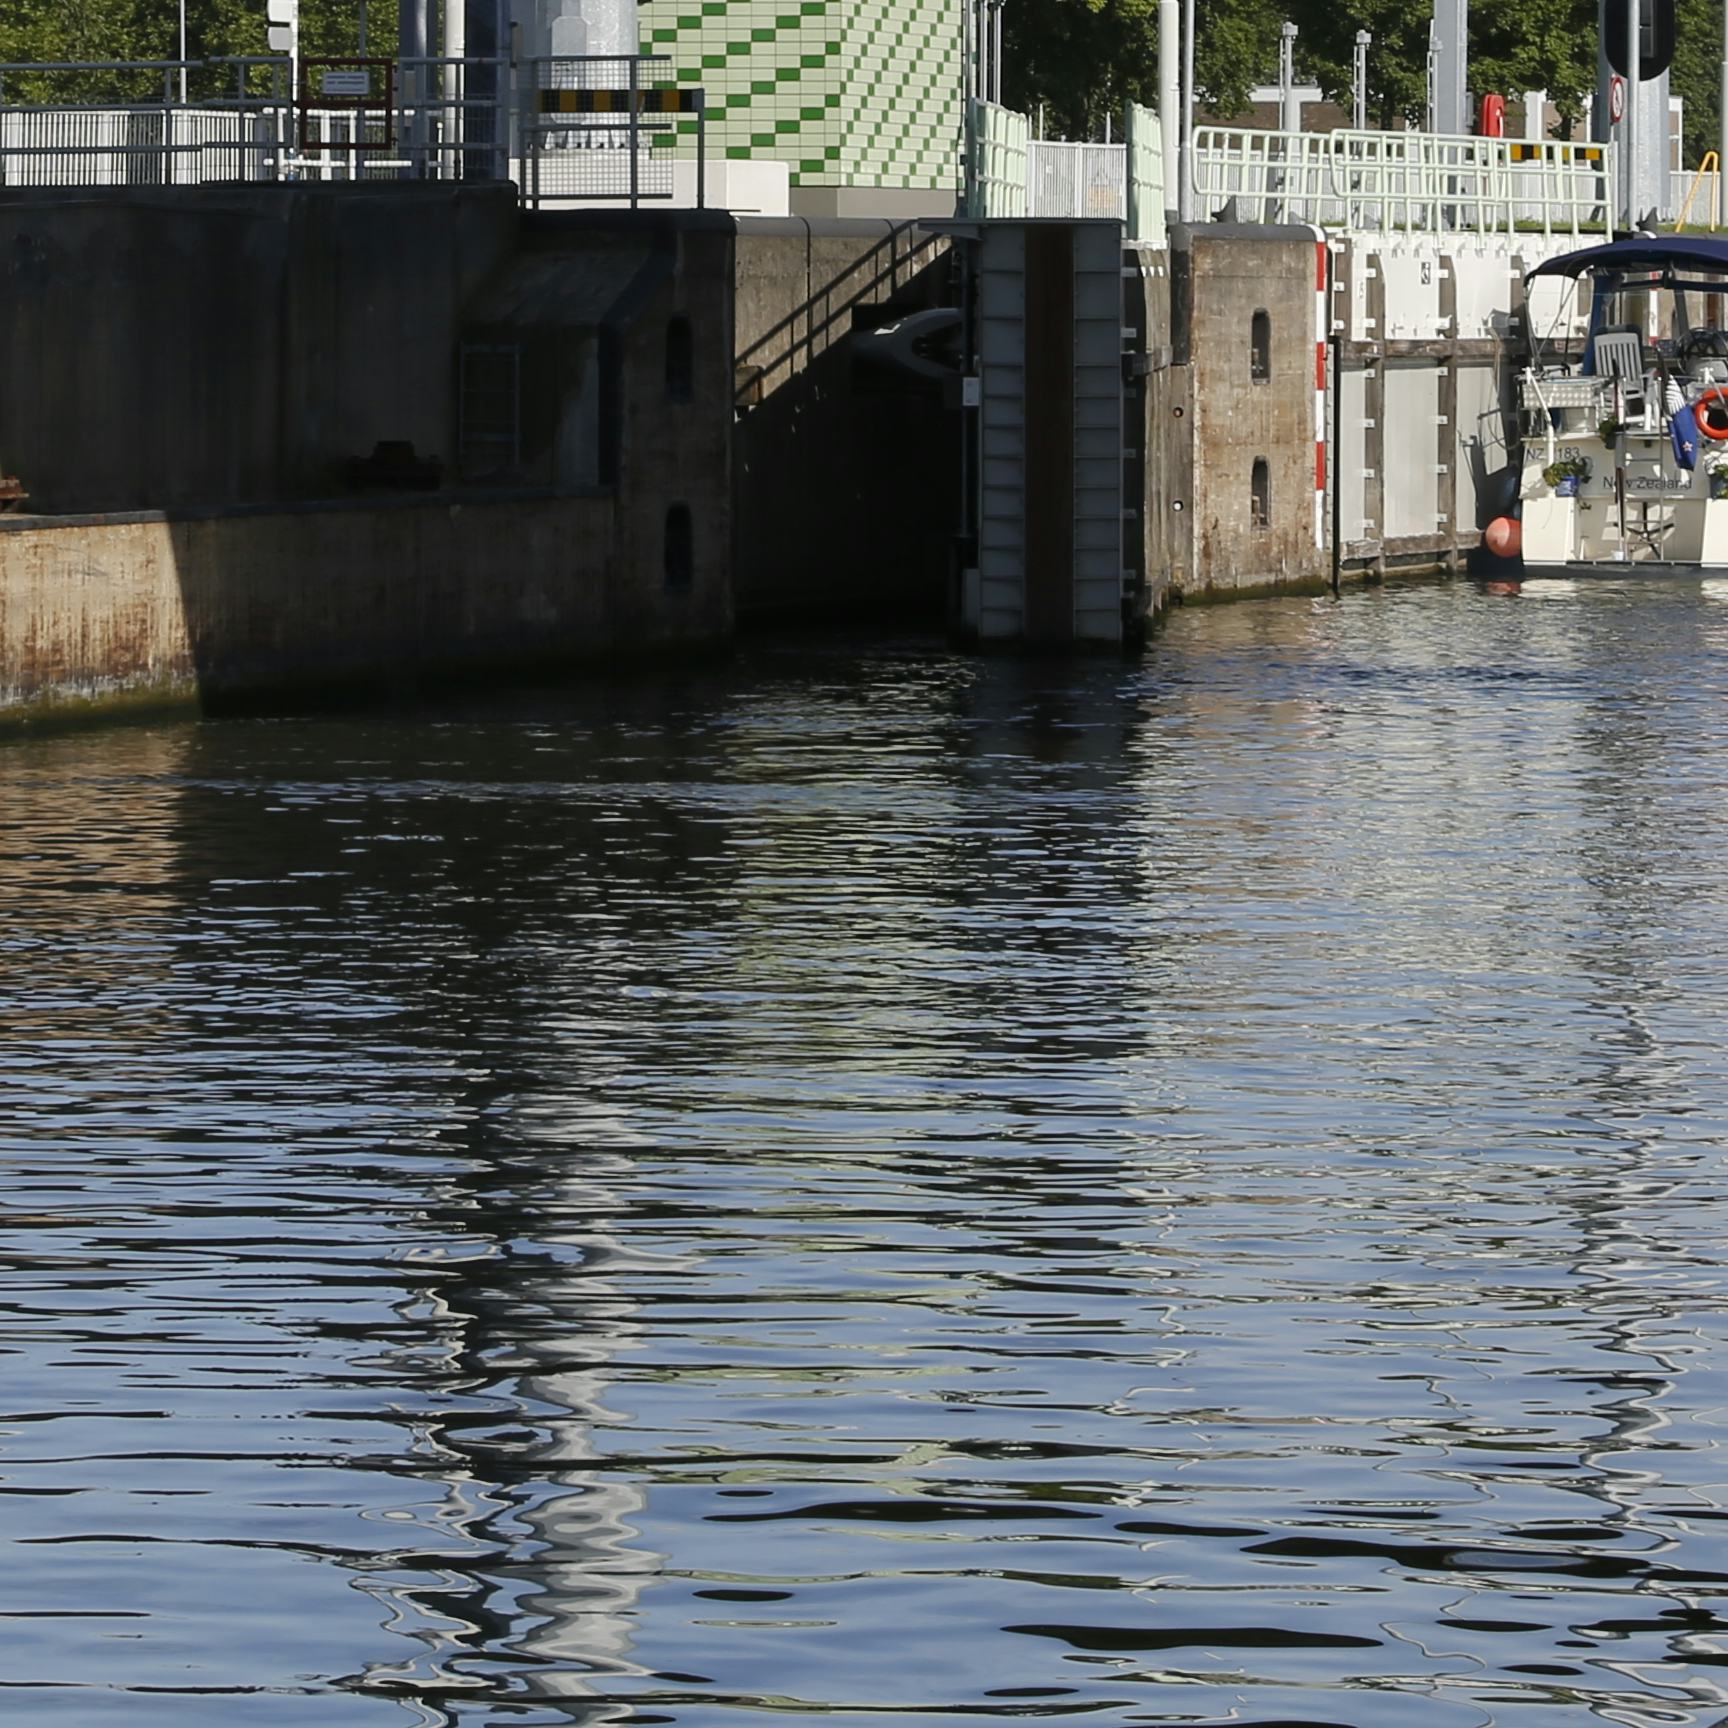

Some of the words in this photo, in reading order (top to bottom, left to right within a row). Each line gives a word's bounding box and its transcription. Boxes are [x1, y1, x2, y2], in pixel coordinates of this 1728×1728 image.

[1526, 447, 1547, 460] NZ
[1603, 476, 1633, 489] Nw
[1636, 476, 1692, 489] Zealand
